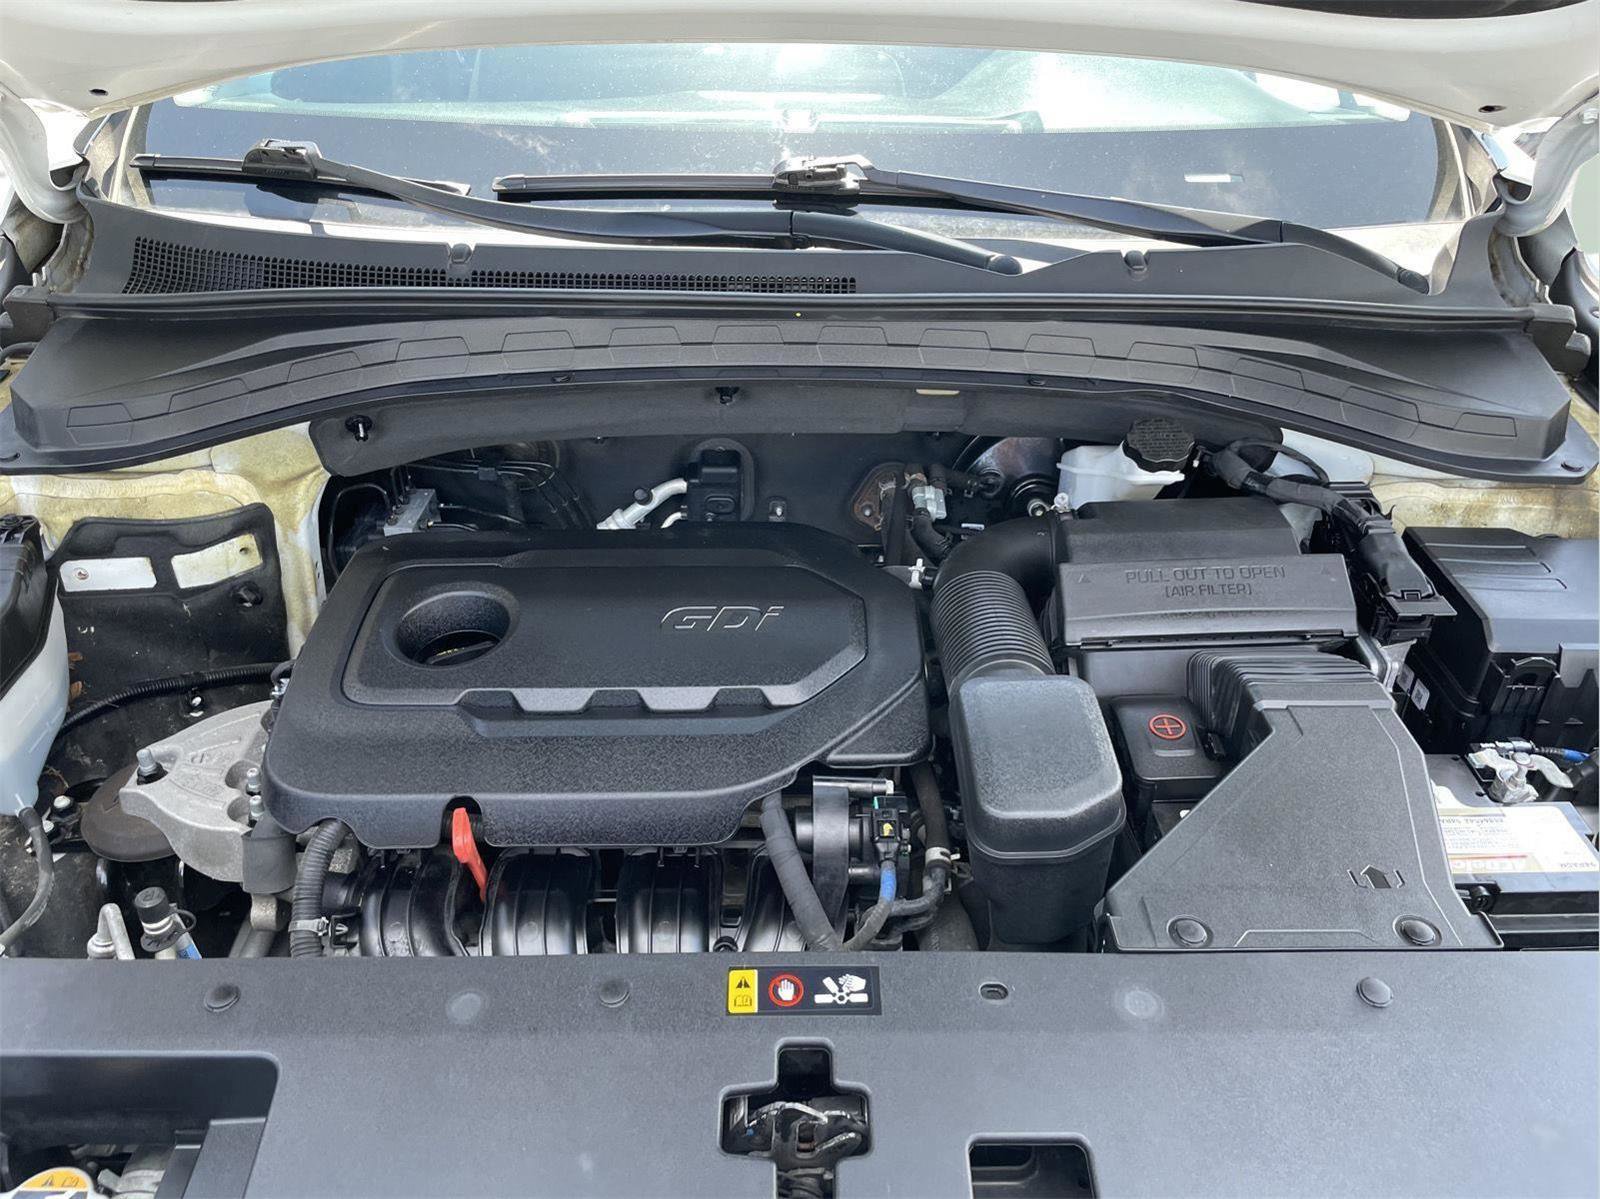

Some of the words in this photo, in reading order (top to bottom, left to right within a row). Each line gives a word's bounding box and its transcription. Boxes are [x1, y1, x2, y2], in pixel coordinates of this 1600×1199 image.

[1124, 569, 1170, 584] PULL
[1173, 567, 1208, 582] OUT
[1211, 566, 1235, 581] TO
[1238, 565, 1286, 580] OPEN
